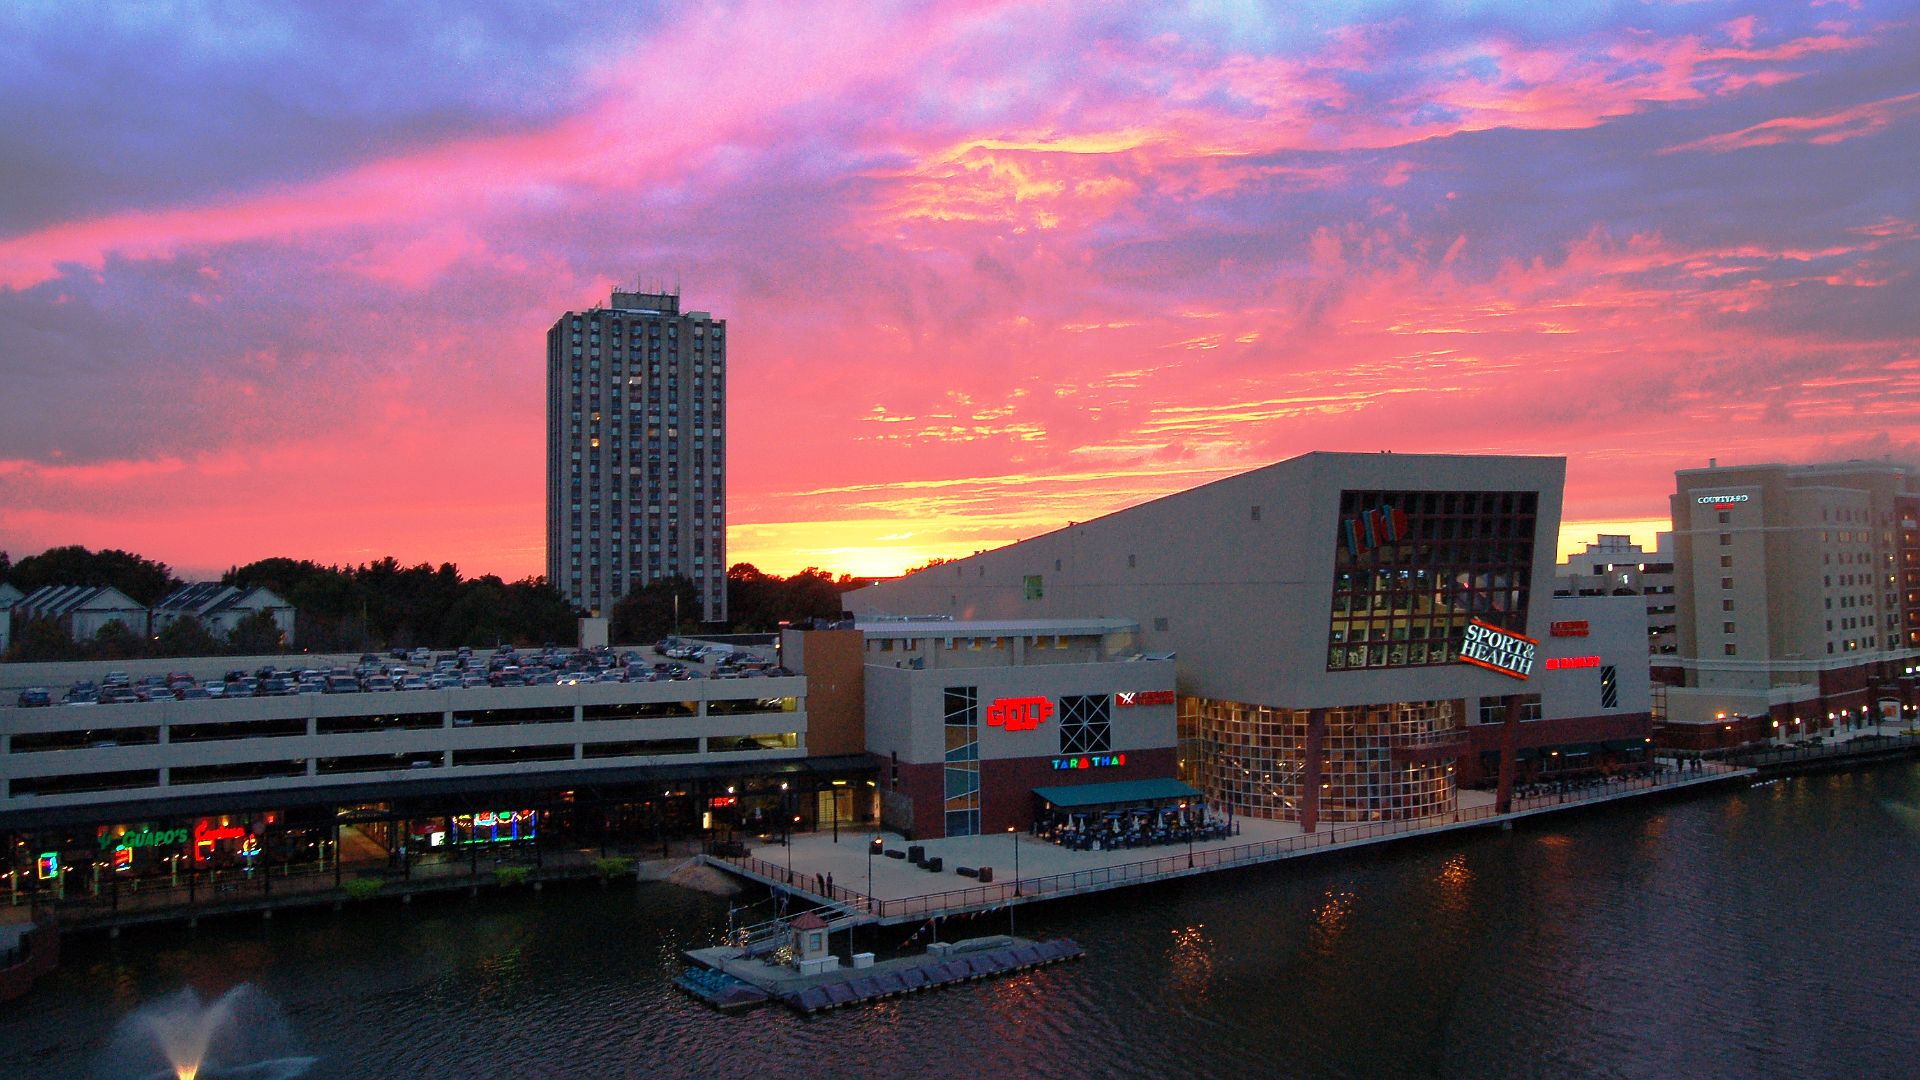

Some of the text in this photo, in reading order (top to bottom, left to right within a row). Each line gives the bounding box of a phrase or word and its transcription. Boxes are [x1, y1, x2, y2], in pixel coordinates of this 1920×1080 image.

[1697, 494, 1749, 504] COURTYARD
[1461, 640, 1533, 675] HEALTH
[988, 696, 1054, 731] GOLF
[1052, 753, 1127, 770] TARA THAI
[122, 829, 188, 848] GUAPO'S
